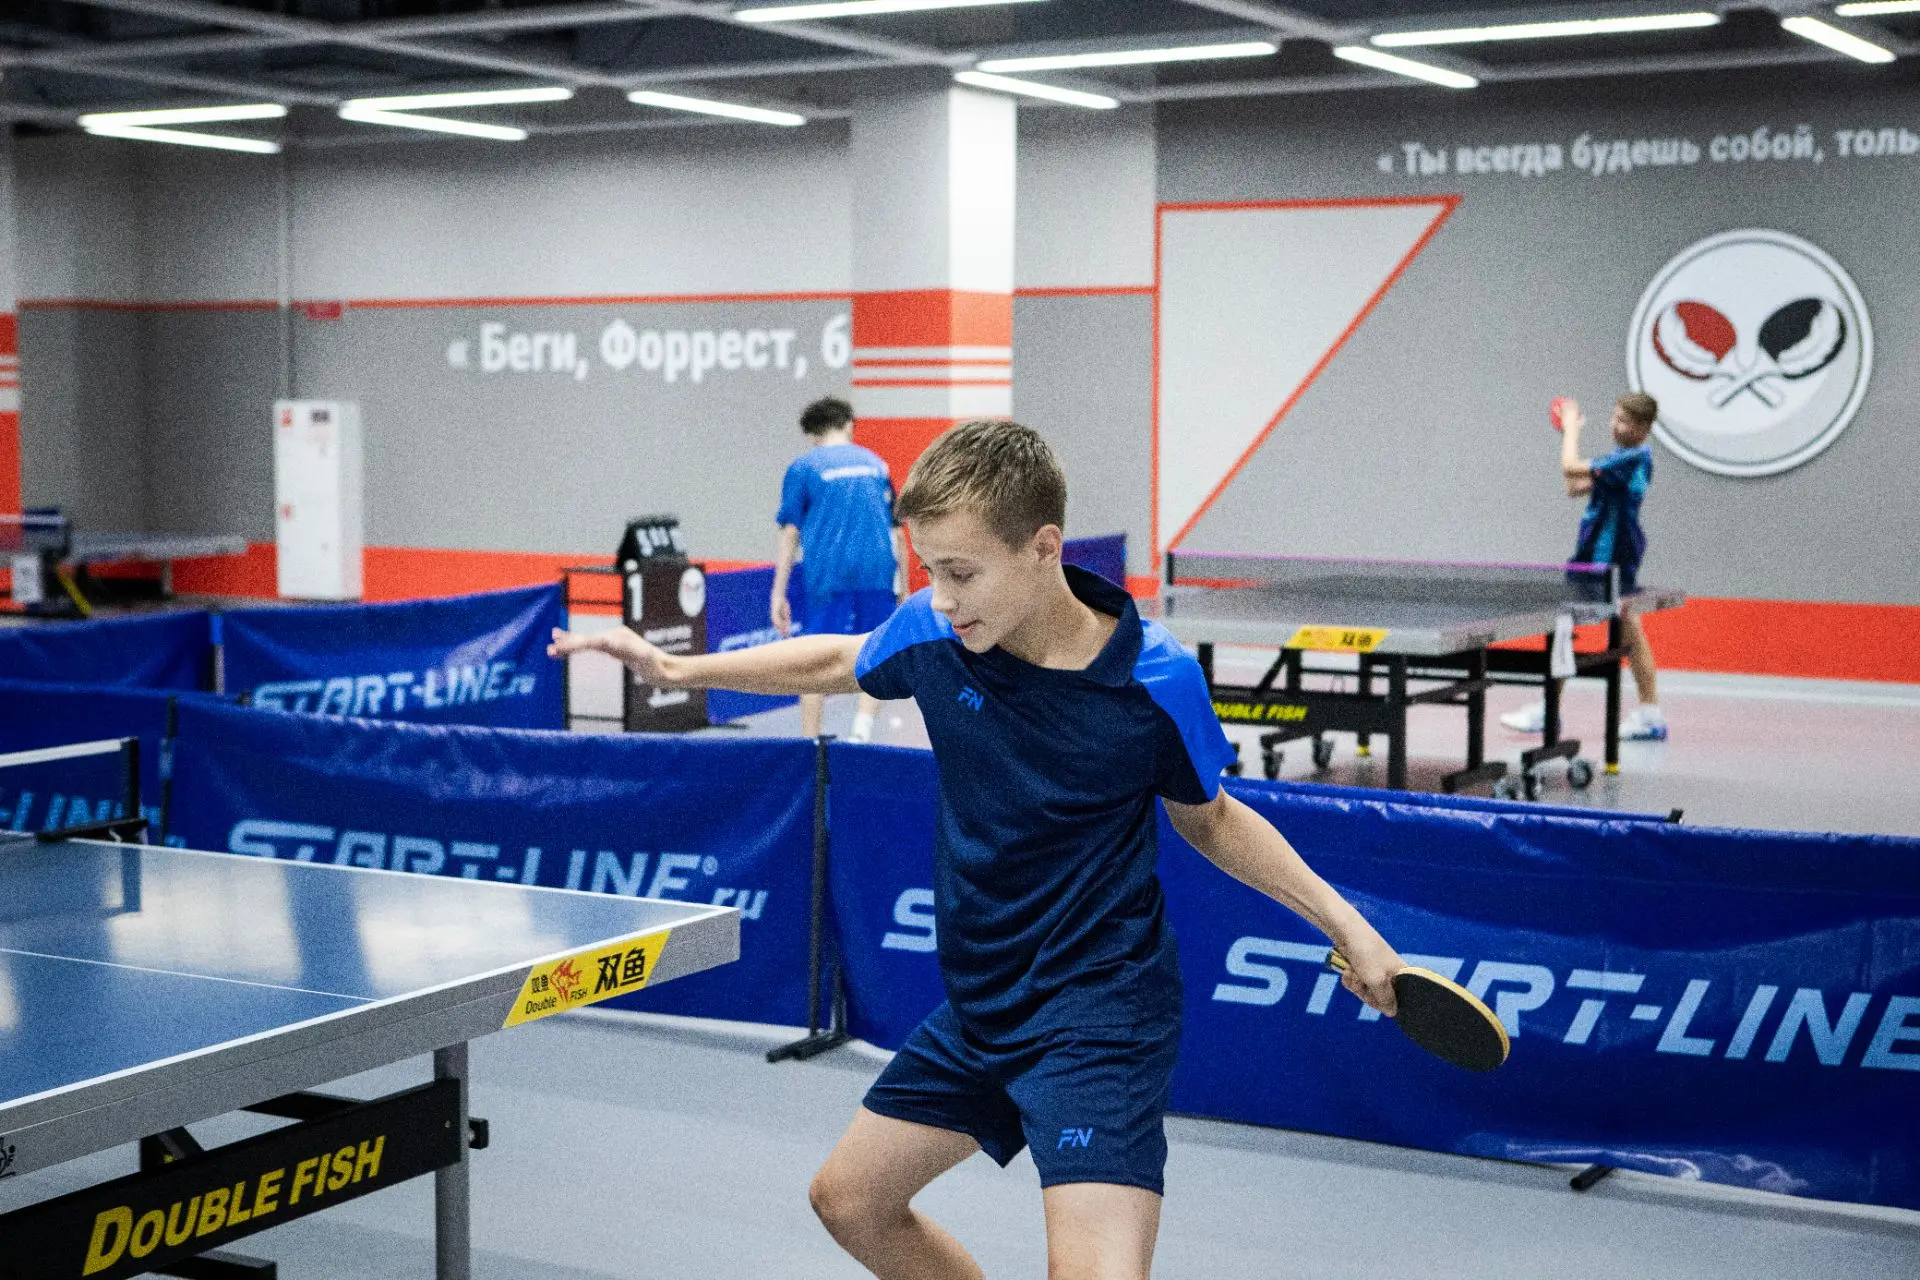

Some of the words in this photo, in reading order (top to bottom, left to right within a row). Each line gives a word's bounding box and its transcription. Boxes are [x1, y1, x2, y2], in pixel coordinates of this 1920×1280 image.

[1402, 142, 1447, 174] Ты
[1456, 144, 1563, 177] всегда
[1570, 131, 1700, 177] будешь
[1709, 124, 1824, 164] собой,
[480, 322, 588, 381] Беги,
[600, 319, 807, 382] Форрест,
[593, 947, 645, 995] 双鱼
[1212, 936, 1920, 1071] STRT-LINE
[288, 1135, 386, 1205] FISH
